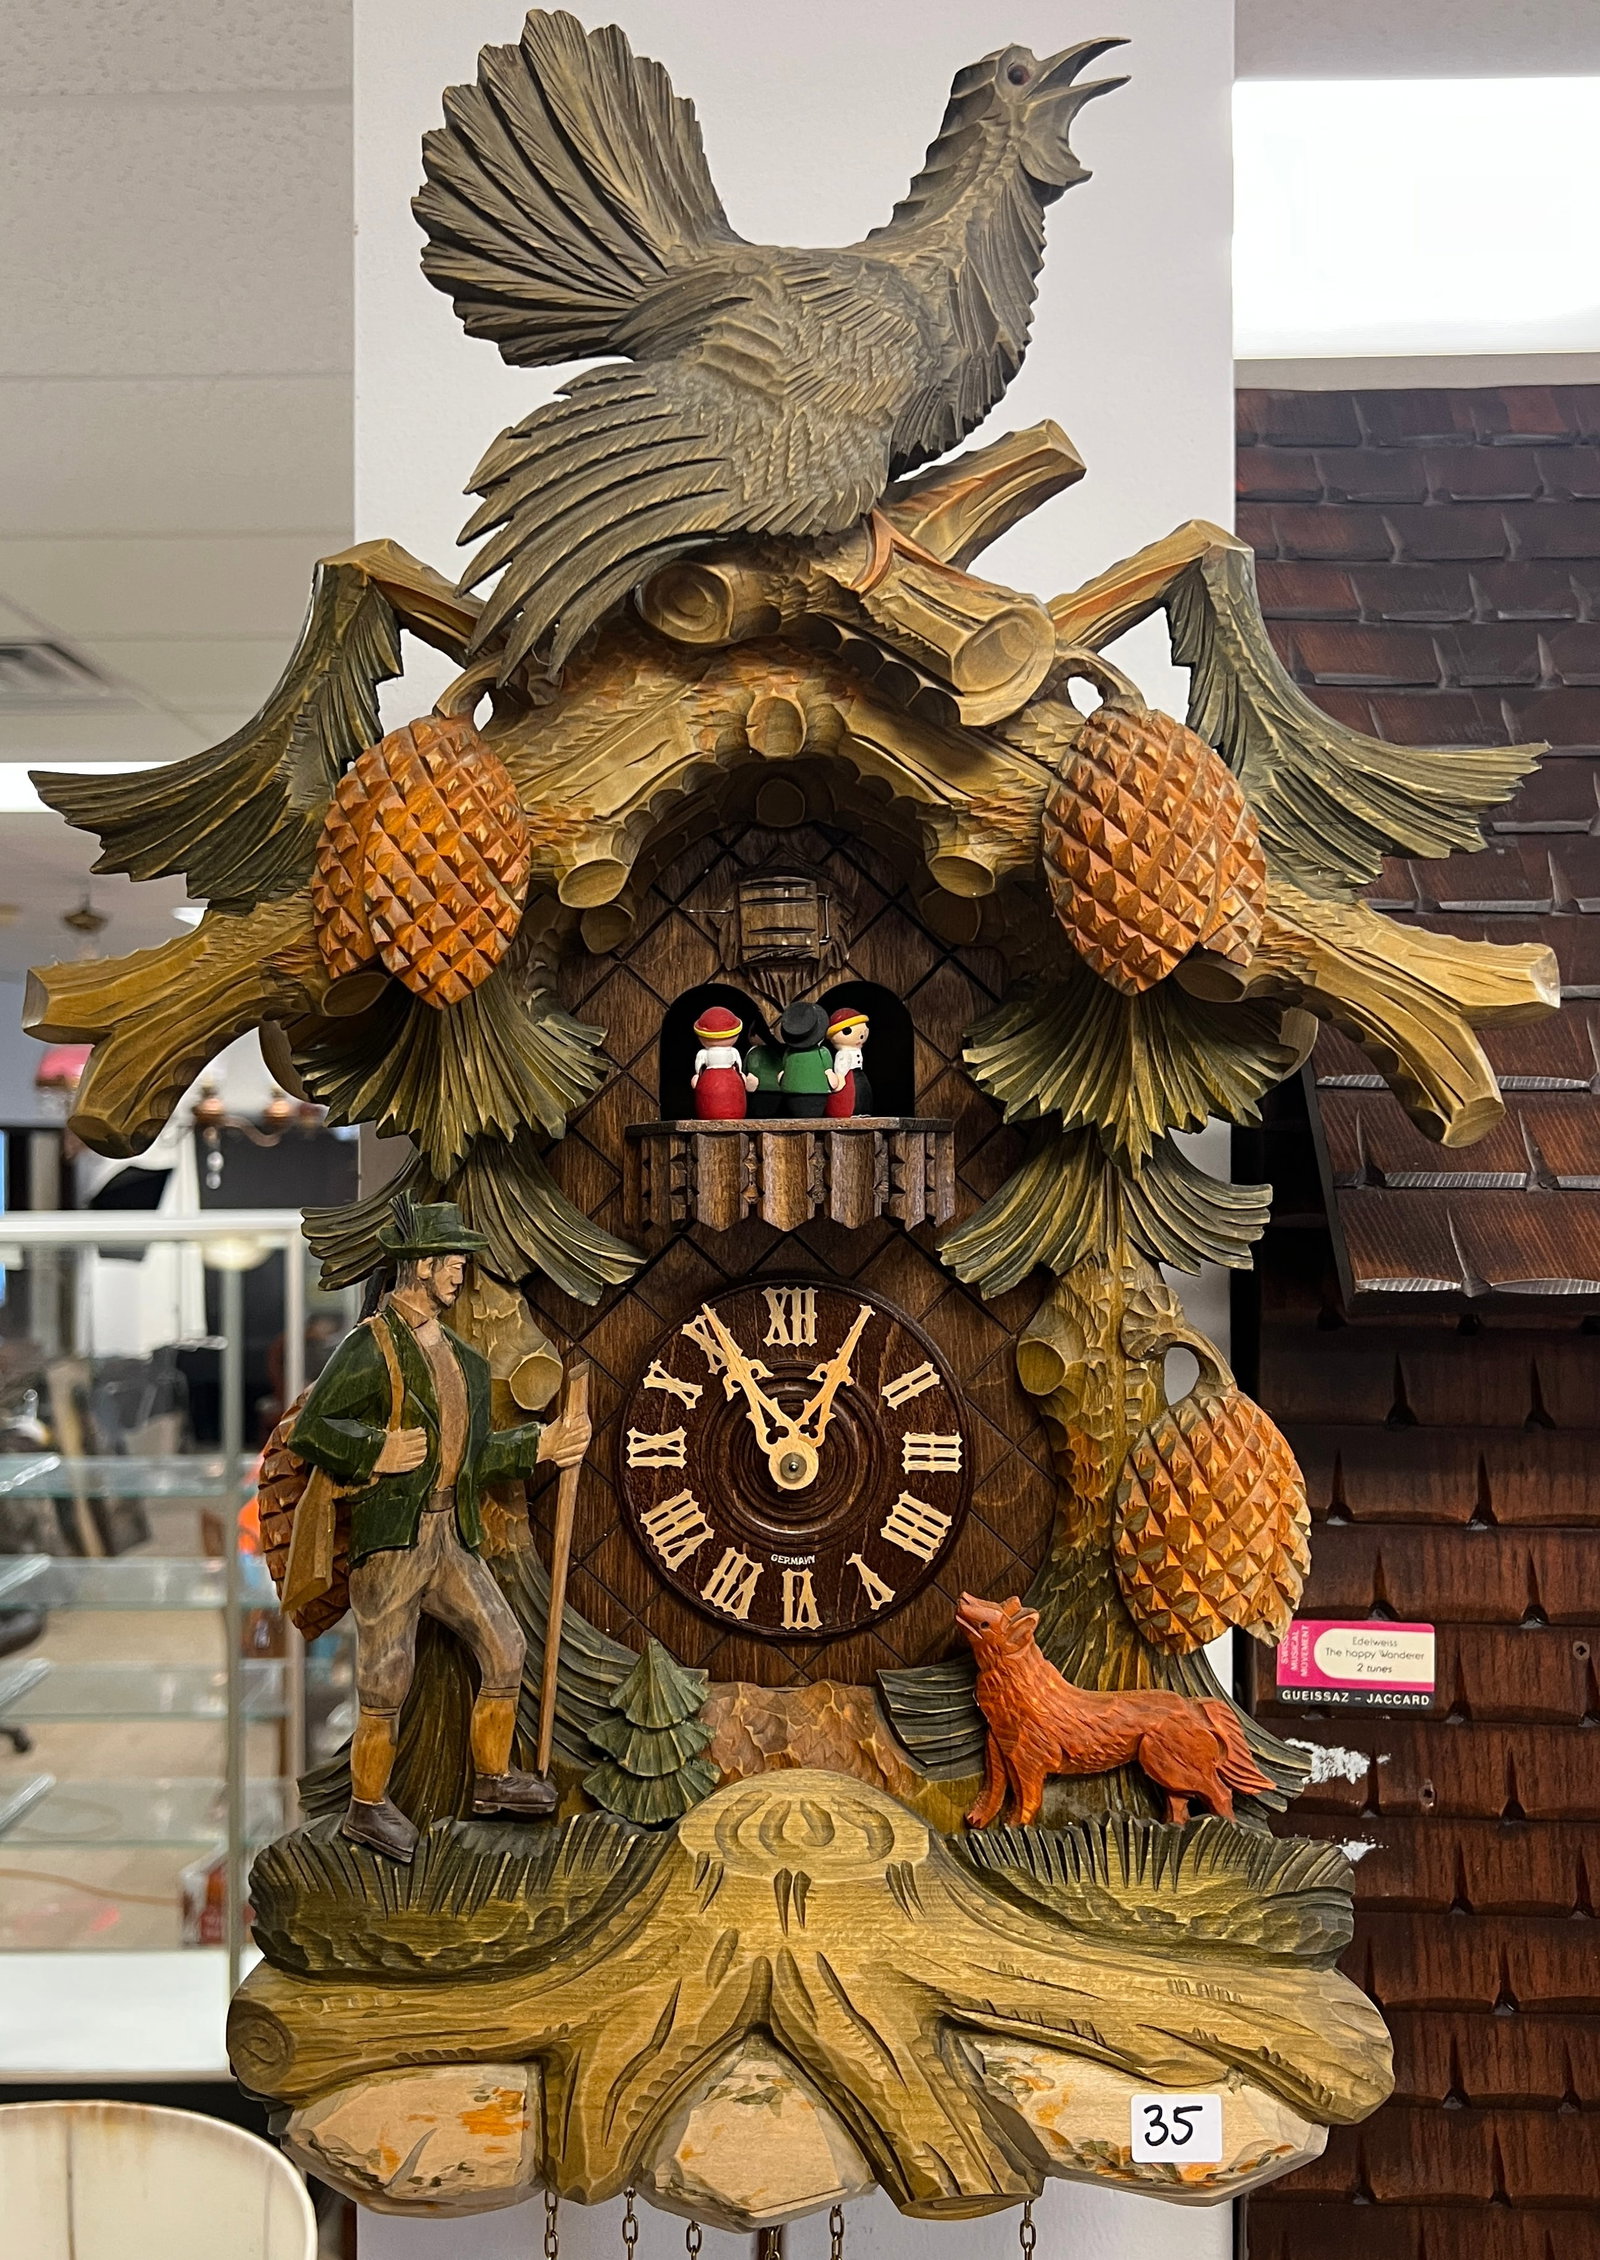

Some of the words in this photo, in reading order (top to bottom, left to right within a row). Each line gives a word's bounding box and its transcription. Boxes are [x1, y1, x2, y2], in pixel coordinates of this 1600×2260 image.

[761, 1286, 818, 1347] XII
[643, 1359, 703, 1410] X
[880, 1360, 940, 1411] II
[626, 1425, 687, 1469] IX
[902, 1430, 963, 1475] III
[640, 1488, 715, 1573] VIII
[880, 1490, 953, 1563] IIII
[700, 1546, 764, 1620] VII
[770, 1553, 816, 1566] GERMANY
[846, 1553, 896, 1611] V
[780, 1567, 823, 1631] VI
[1290, 1629, 1300, 1671] MUSICAL
[1300, 1624, 1309, 1678] MOVEMENT
[1325, 1647, 1342, 1657] The
[1345, 1648, 1376, 1660] happy
[1378, 1649, 1425, 1660] Wanderer
[1351, 1636, 1398, 1647] Edelweiss
[1356, 1663, 1364, 1672] 2
[1366, 1664, 1392, 1673] tunes
[1282, 1690, 1350, 1703] GUEISSAZ
[1366, 1693, 1430, 1706] JACCARD
[1143, 2104, 1203, 2147] 35
